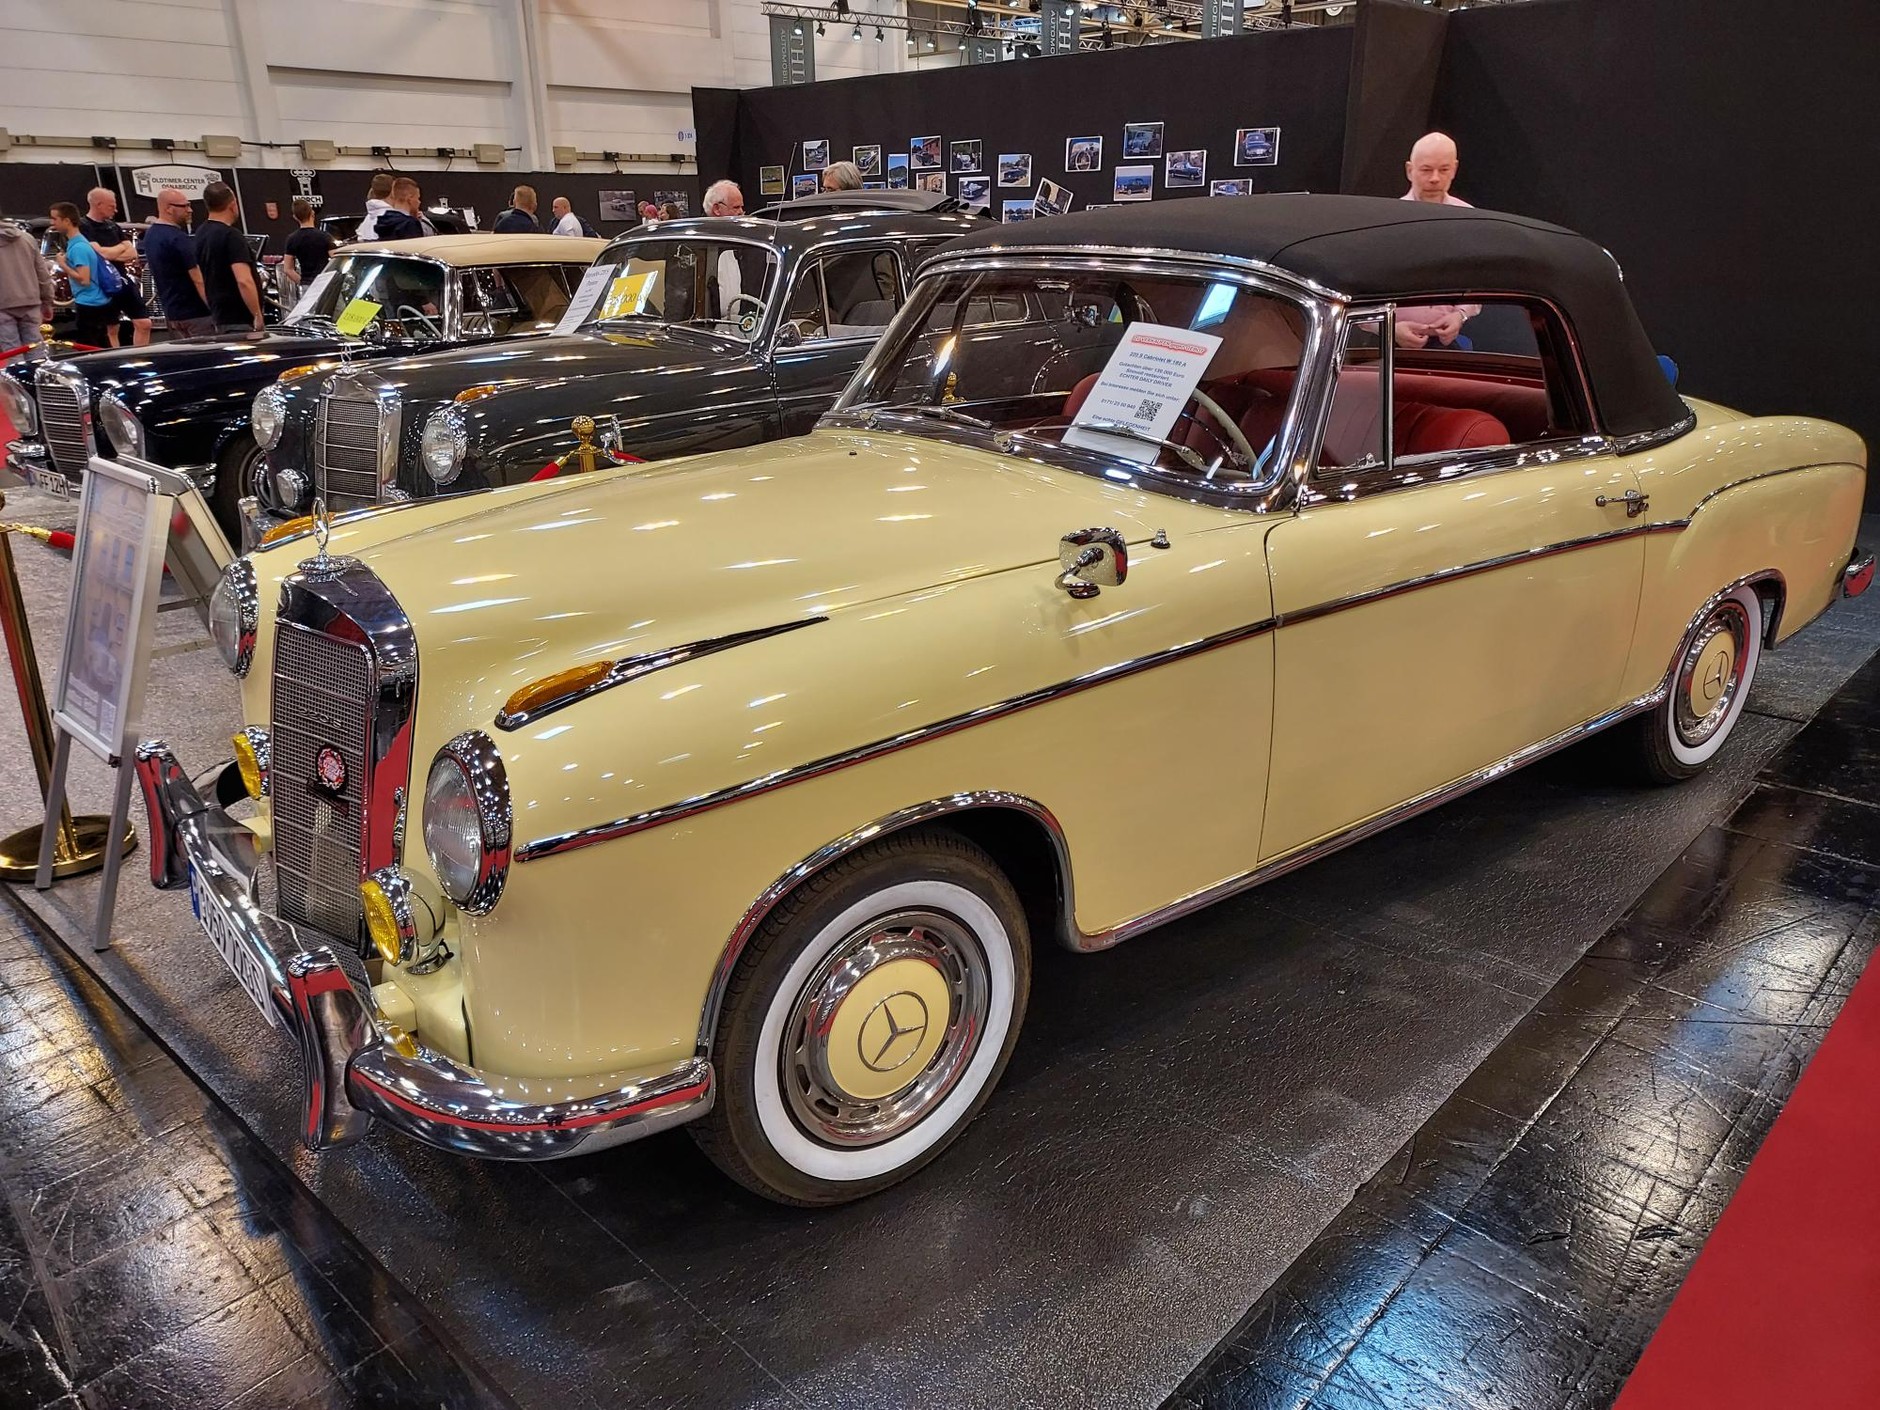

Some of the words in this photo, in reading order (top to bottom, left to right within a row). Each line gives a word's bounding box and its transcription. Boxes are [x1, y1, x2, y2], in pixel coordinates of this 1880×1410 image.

[1143, 354, 1166, 362] Cabriolet
[1119, 361, 1142, 369] Gutachten
[1119, 373, 1139, 381] ECHTER
[1139, 376, 1153, 384] DAILY
[1153, 379, 1173, 387] DRIVER
[1116, 419, 1151, 431] GELEGENHEIT
